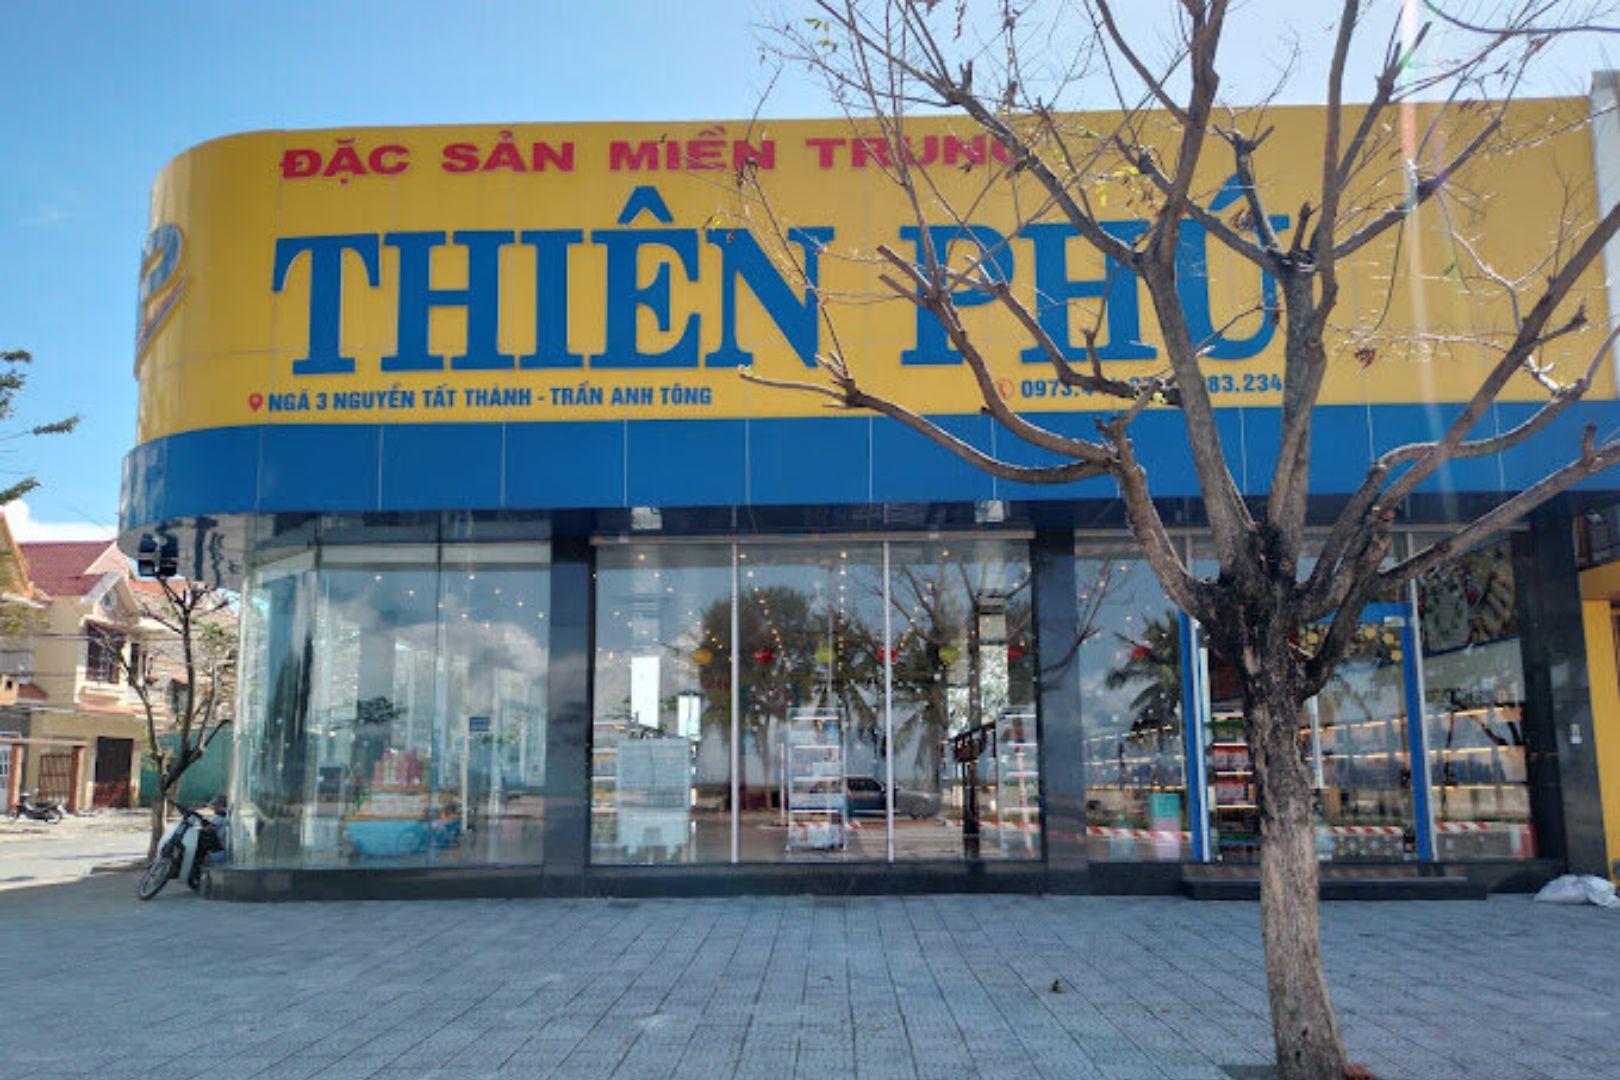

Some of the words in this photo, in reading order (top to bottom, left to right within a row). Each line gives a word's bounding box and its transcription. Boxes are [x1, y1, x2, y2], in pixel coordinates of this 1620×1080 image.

[280, 138, 411, 184] ĐẶC
[441, 130, 575, 173] SẢN
[609, 125, 776, 172] MIỀN
[272, 185, 835, 375] THIÊN
[898, 172, 1291, 366] PHÚ
[268, 387, 311, 412] NGÃ
[315, 392, 328, 411] 3
[422, 382, 457, 408] TẤT
[610, 386, 655, 406] ANH
[660, 382, 713, 406] TÔNG
